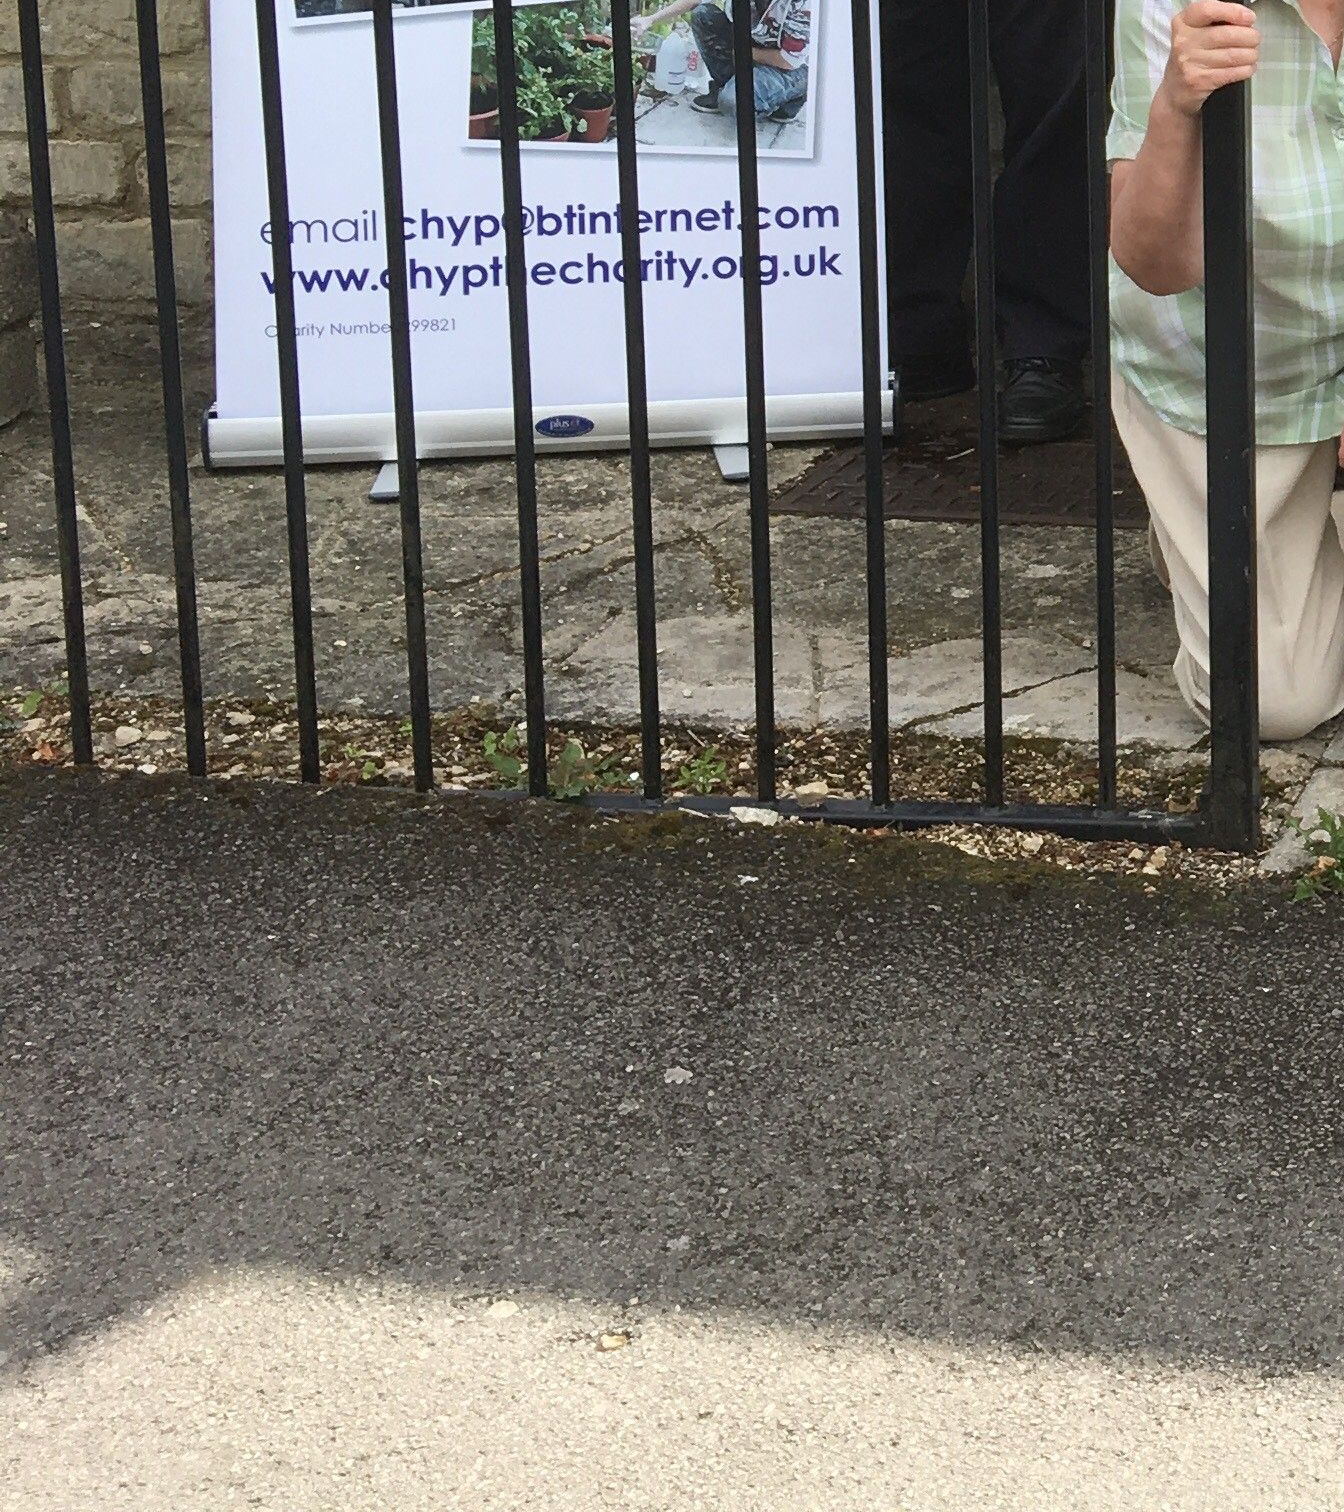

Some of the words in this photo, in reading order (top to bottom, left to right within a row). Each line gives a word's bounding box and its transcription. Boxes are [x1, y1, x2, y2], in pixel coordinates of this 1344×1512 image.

[260, 209, 377, 244] email
[260, 245, 842, 297] www.hyptechrity.og.uk
[264, 321, 324, 339] Carity
[330, 321, 392, 336] Numbe
[408, 318, 456, 333] 99821
